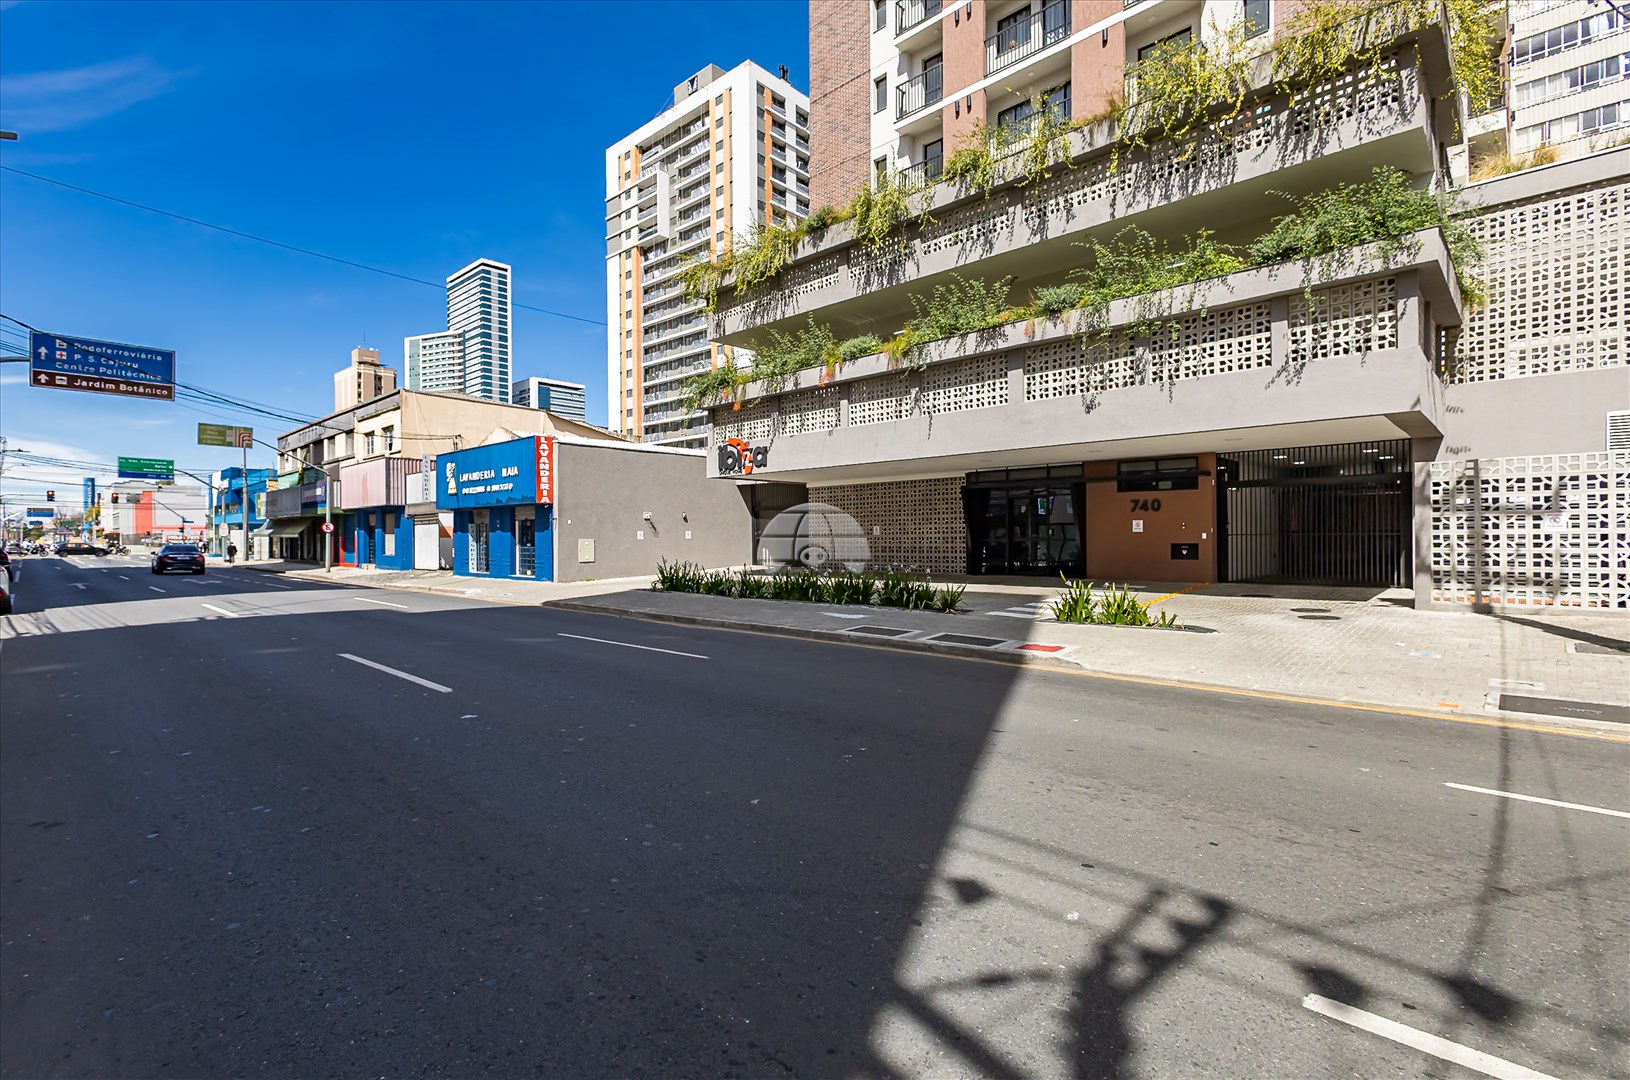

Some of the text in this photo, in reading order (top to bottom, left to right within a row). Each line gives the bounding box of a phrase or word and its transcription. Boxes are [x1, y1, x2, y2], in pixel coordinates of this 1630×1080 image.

[55, 361, 162, 381] Centro Politécnico
[73, 378, 168, 396] Jardim Botânico
[718, 444, 768, 470] ibiza
[460, 469, 495, 482] LAVANDERIA
[539, 436, 550, 503] LAVANDERIA
[1130, 499, 1162, 512] 740
